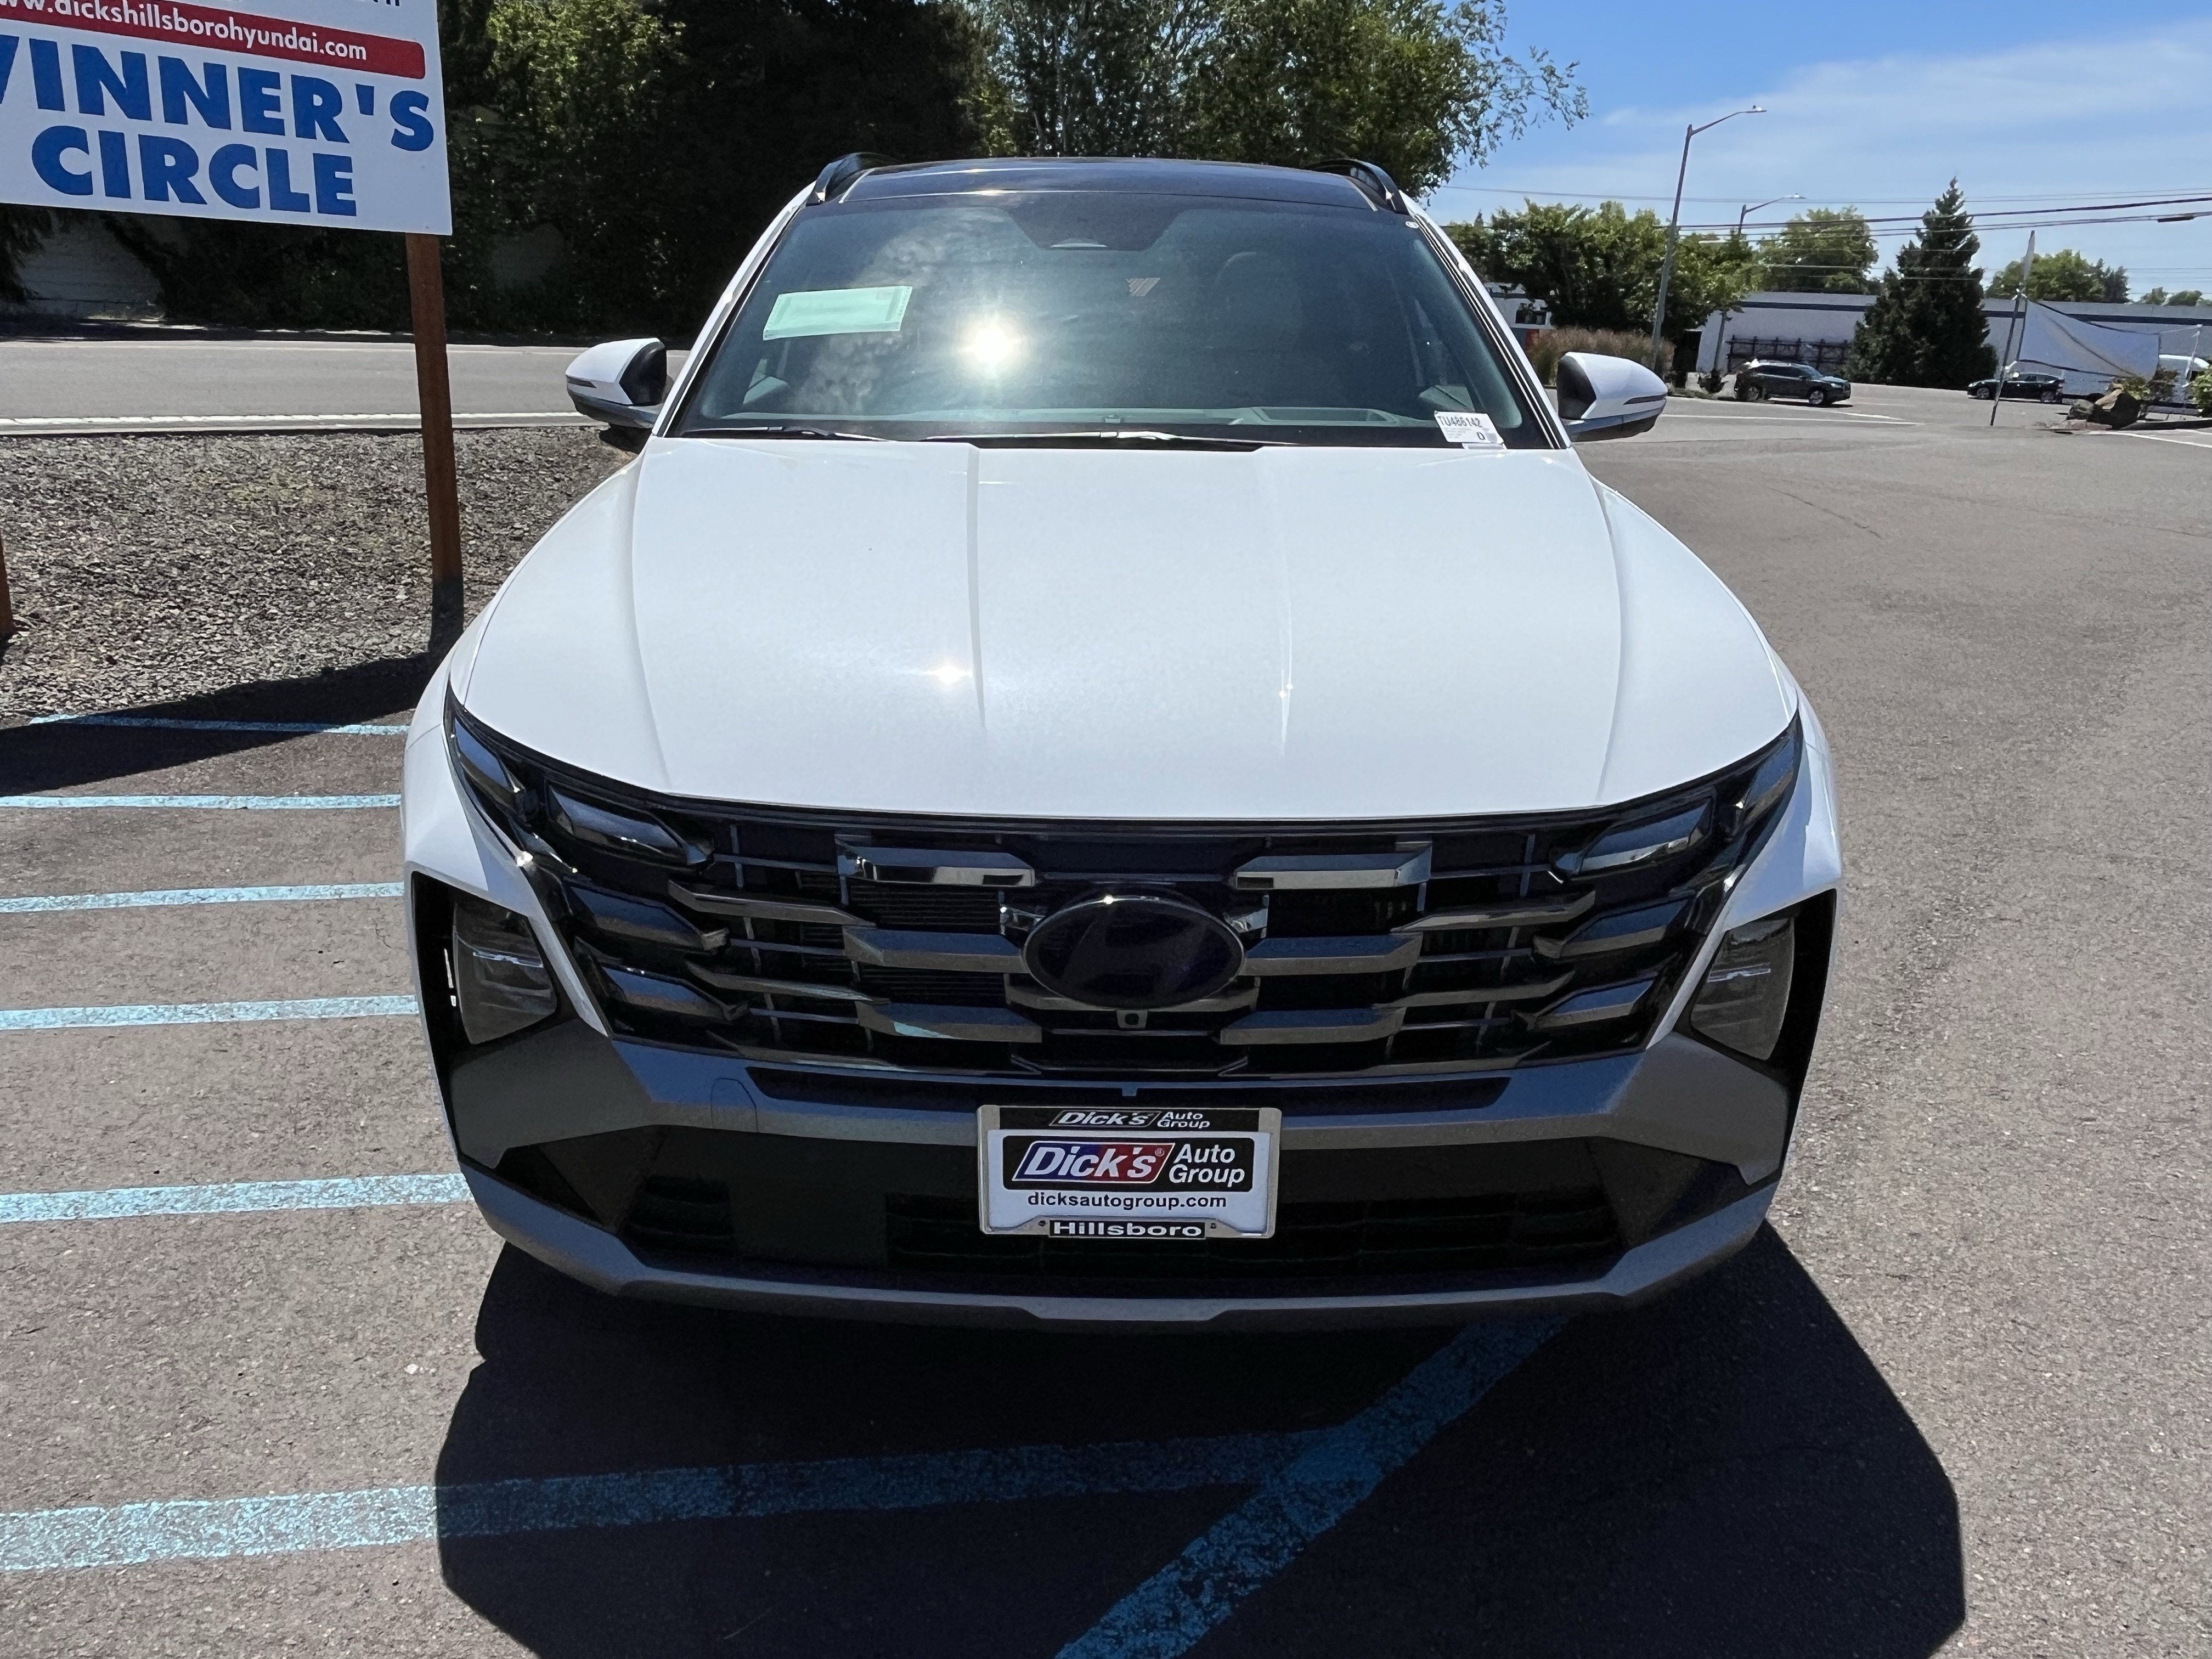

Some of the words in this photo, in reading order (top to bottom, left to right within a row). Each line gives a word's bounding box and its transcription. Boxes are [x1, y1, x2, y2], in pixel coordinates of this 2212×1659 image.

[0, 34, 434, 152] INNER'S
[32, 125, 357, 217] CIRCLE
[1058, 1111, 1149, 1125] Dick's
[1157, 1119, 1210, 1128] Group
[1163, 1111, 1203, 1120] Auto
[1024, 1146, 1157, 1178] Dick's
[1173, 1144, 1235, 1164] Auto
[1169, 1164, 1245, 1187] Group
[1028, 1192, 1227, 1210] dicksautogroup.com
[1053, 1222, 1202, 1237] Hillsboro
